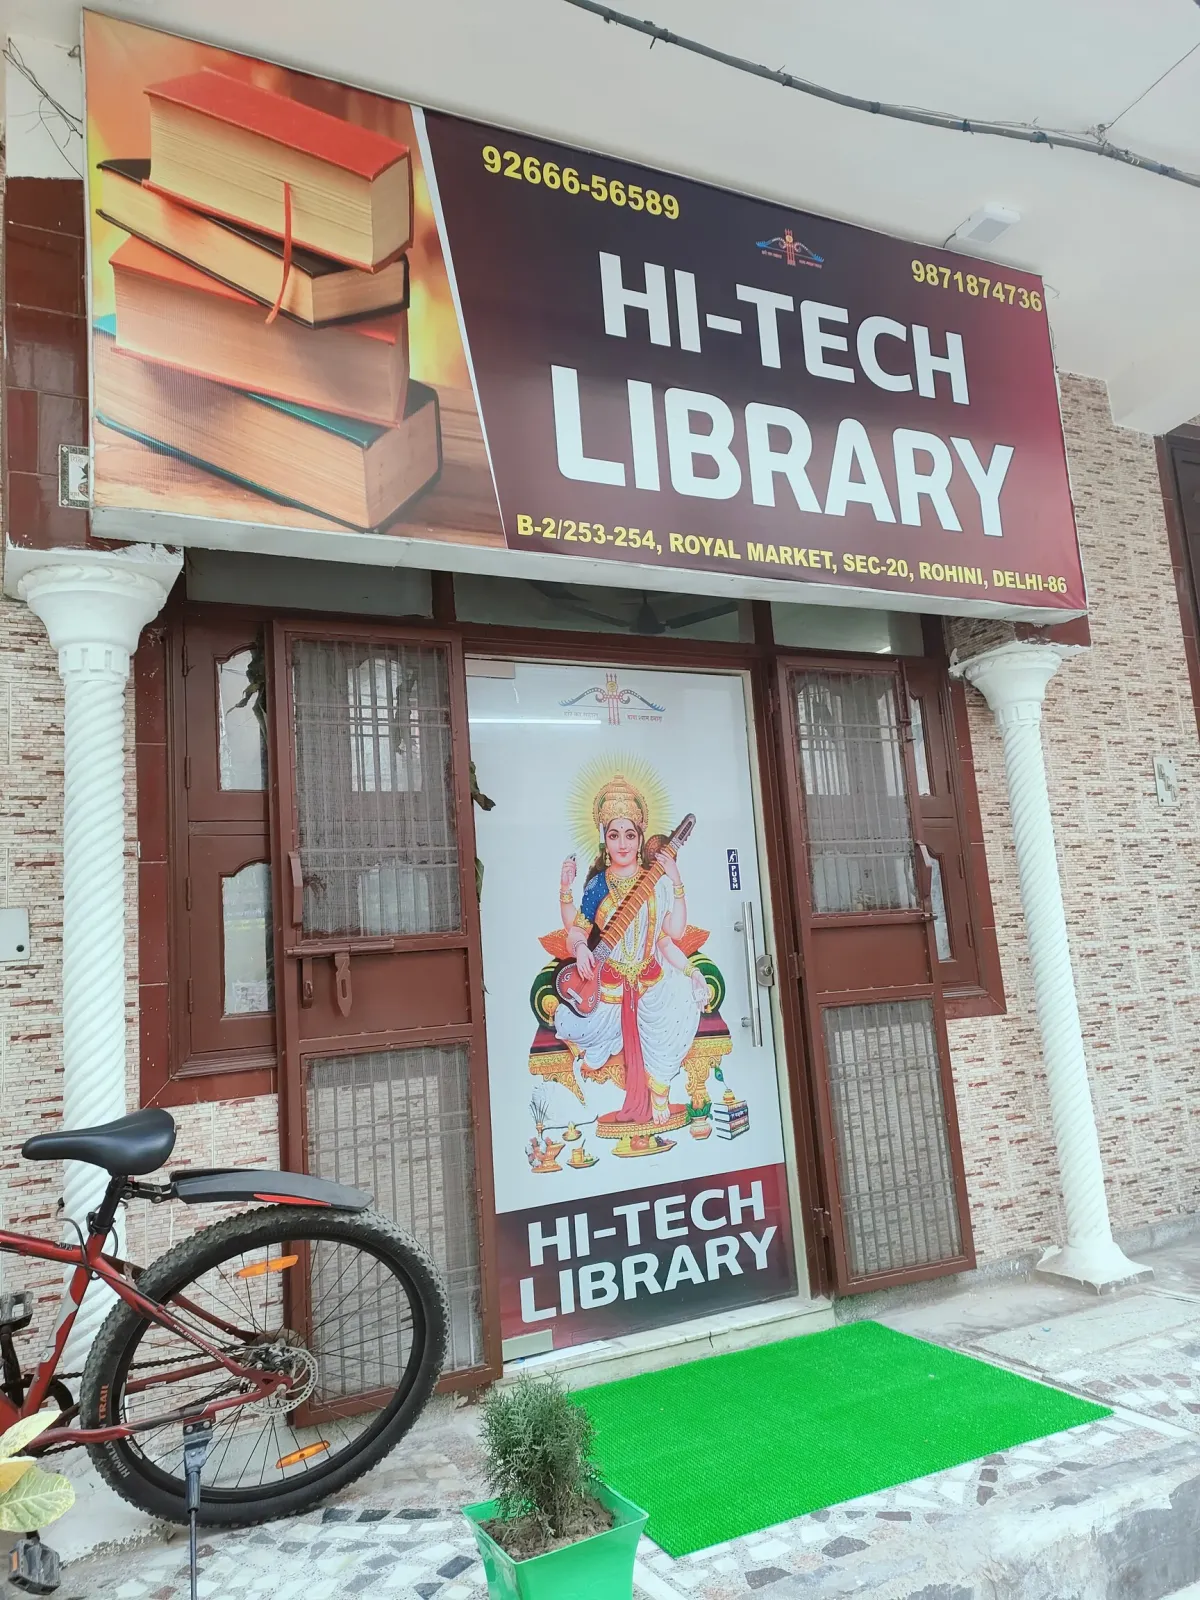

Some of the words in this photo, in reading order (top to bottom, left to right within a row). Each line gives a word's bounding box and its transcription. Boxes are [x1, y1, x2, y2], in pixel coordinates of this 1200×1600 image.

[482, 145, 680, 220] 92666-56589
[911, 259, 1043, 312] 9871874736
[599, 251, 970, 405] HI-TECH
[551, 364, 1015, 537] LIBRARY
[516, 514, 663, 553] B-2/253-254,
[669, 533, 741, 560] ROYAL
[747, 542, 838, 575] MARKET,
[843, 555, 916, 582] SEC-20,
[919, 561, 988, 589] ROHINI,
[992, 570, 1068, 593] DELHI-86
[731, 865, 739, 889] PUSH
[528, 1180, 766, 1267] HI-TECH
[519, 1225, 778, 1324] LIBRARY
[99, 1384, 110, 1421] TRAIL
